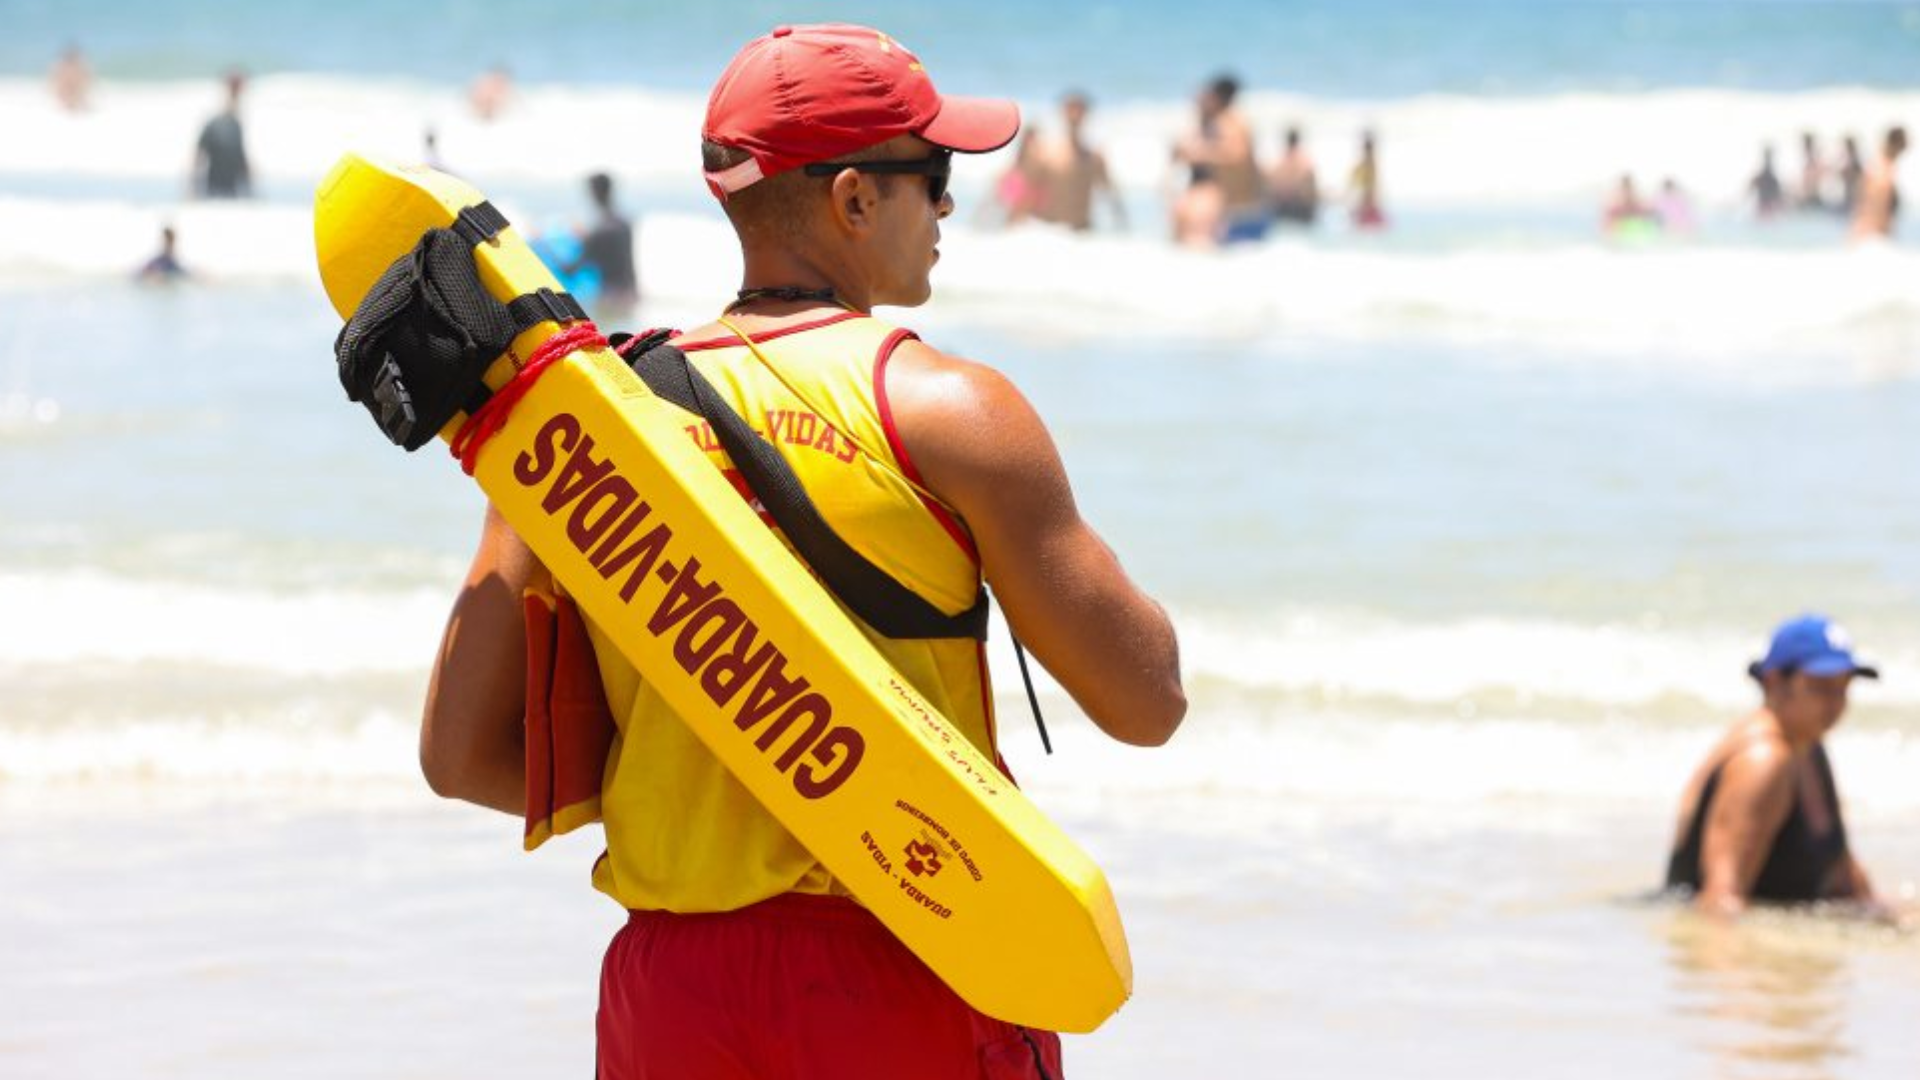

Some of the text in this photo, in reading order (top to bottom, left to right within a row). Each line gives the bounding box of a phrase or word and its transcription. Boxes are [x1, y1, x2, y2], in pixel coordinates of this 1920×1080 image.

[513, 413, 866, 800] GUARDA-VIDAS
[895, 799, 950, 839] BOMBEIROS
[861, 831, 892, 875] VIDAS
[949, 838, 962, 852] DE
[959, 851, 983, 882] CORPO
[900, 878, 952, 919] GUARDA
